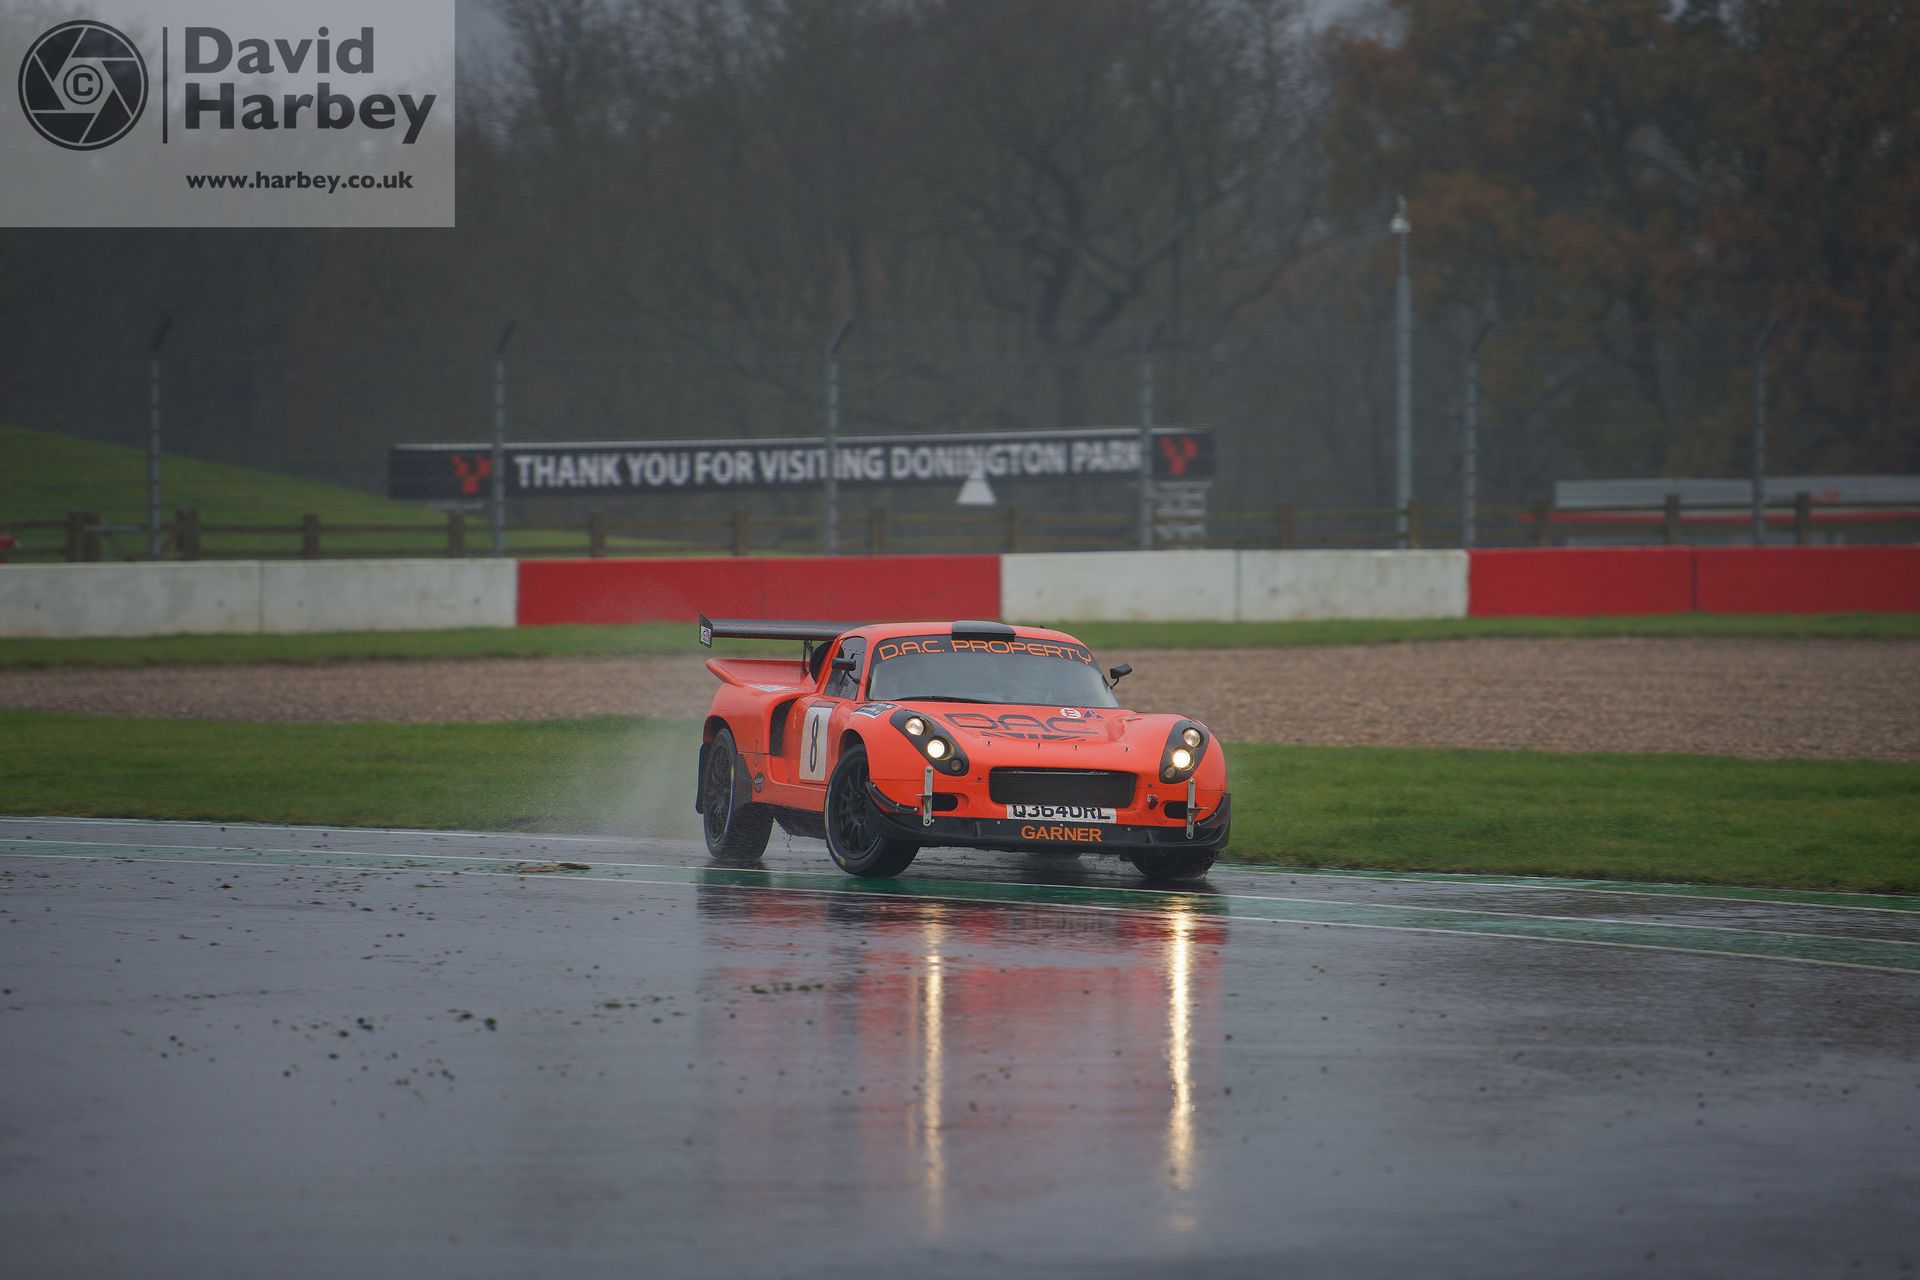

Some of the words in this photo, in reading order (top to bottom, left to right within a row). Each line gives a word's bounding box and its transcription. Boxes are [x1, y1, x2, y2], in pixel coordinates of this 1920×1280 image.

[515, 455, 622, 488] THANK
[626, 453, 692, 486] YOU
[696, 452, 755, 485] FOR
[758, 447, 884, 483] VISITING
[890, 442, 1066, 479] DONINGTON
[1071, 440, 1142, 473] PARK
[951, 640, 1092, 664] PROPERTY
[944, 713, 1099, 734] DAC
[810, 714, 820, 773] 8
[1021, 825, 1103, 843] GARNER
